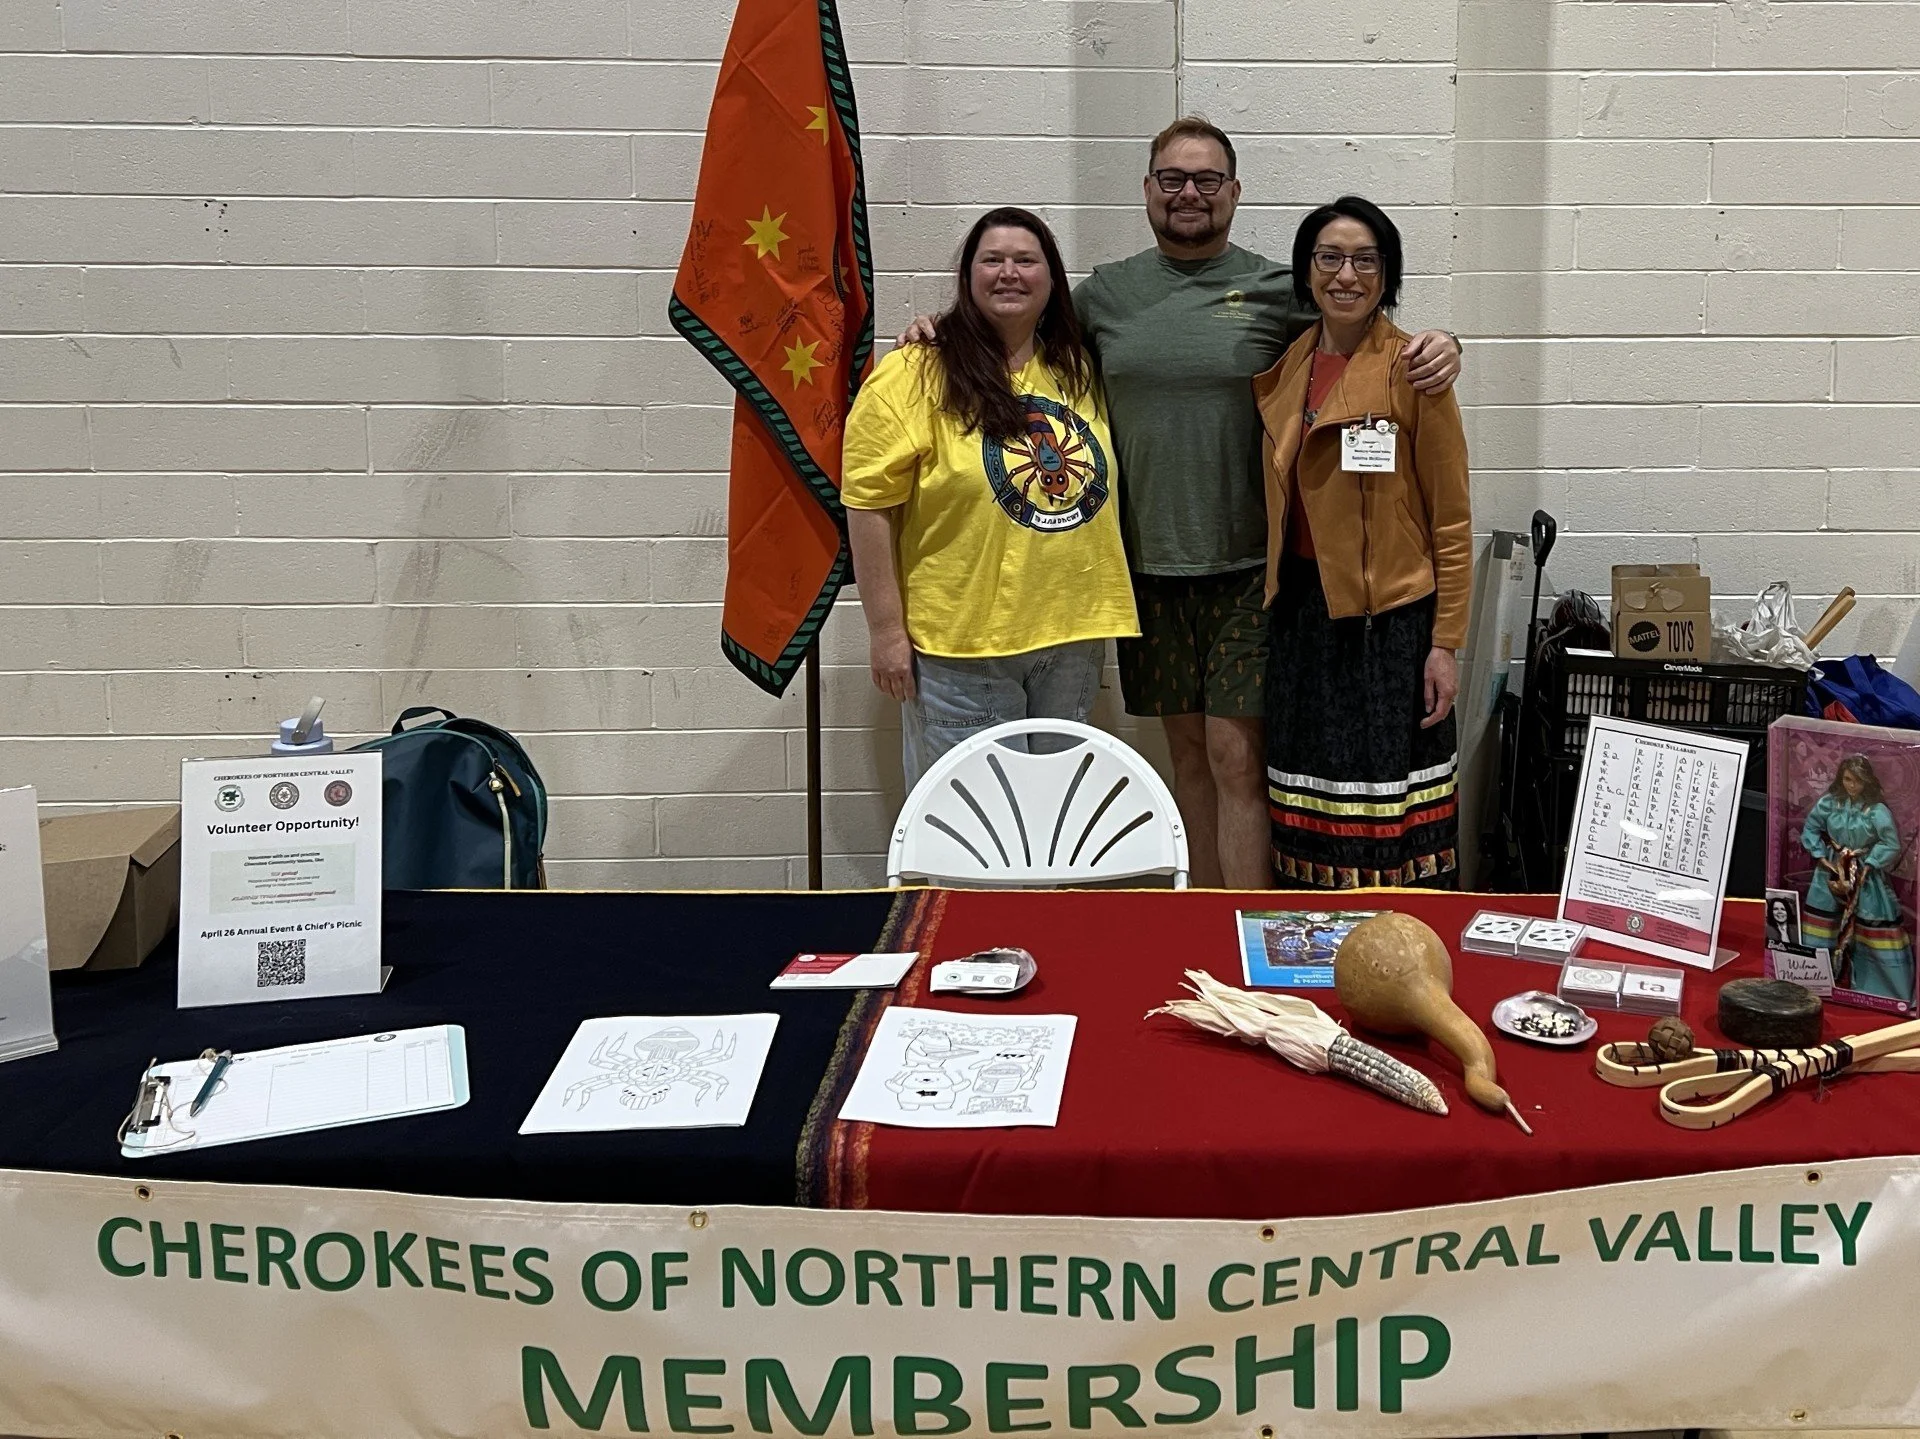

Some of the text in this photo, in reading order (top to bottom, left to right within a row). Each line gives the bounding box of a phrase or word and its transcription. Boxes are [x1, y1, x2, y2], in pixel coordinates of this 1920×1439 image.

[1628, 620, 1694, 652] MATTEL TOYS
[1664, 663, 1703, 673] CleverMade
[214, 774, 252, 782] CHEROKEES
[263, 770, 299, 779] NORTHERN
[207, 816, 360, 835] Volunteer Opportunity!
[200, 920, 362, 940] April 26 Annual Event & Chief's Picnic
[1788, 958, 1818, 970] Wilma
[1636, 980, 1665, 993] ta
[97, 1201, 1874, 1321] CHEROKEES OF NORTHERN CENTRAL VALLEY
[521, 1314, 1452, 1436] MEMBERSHIP
